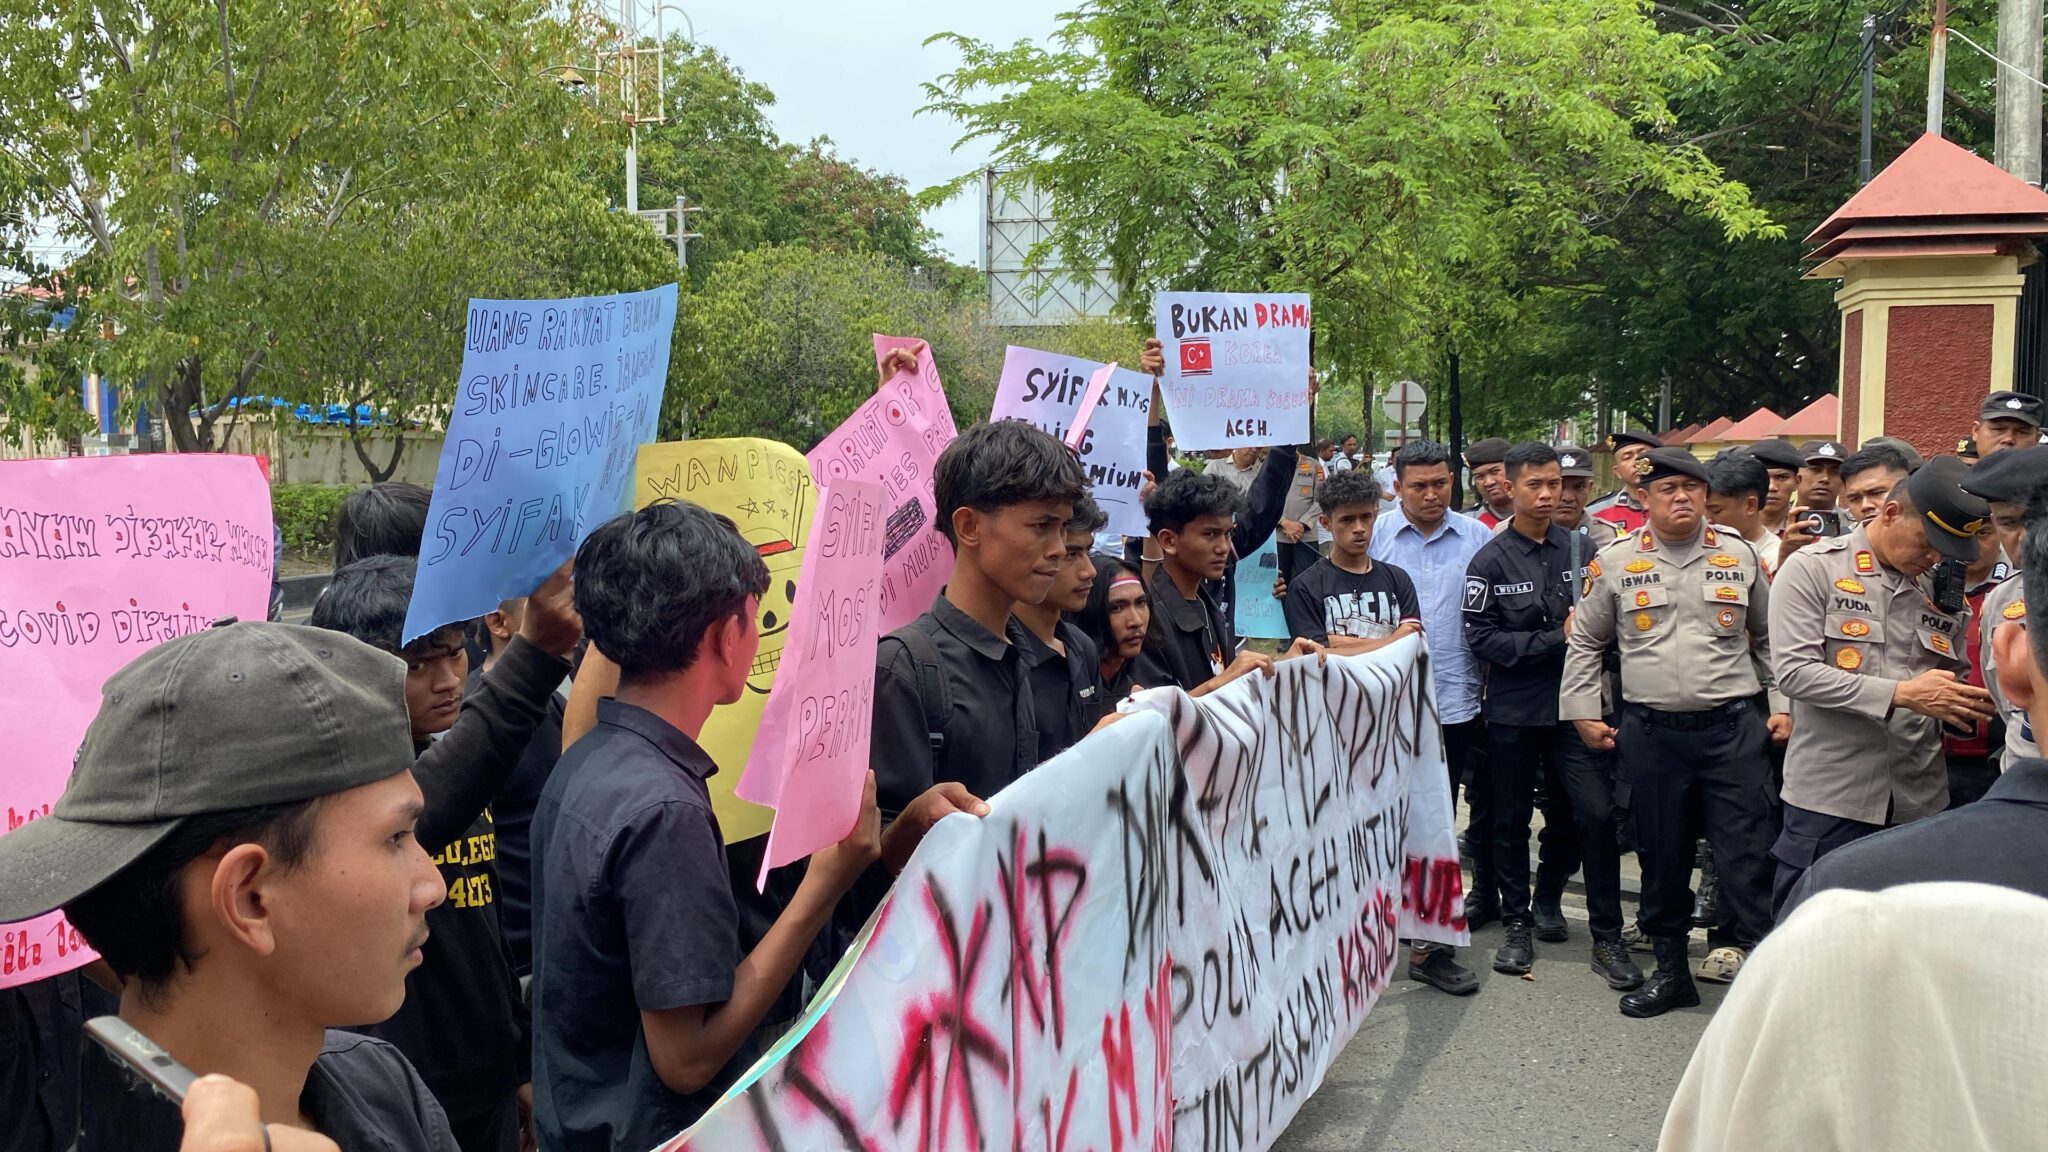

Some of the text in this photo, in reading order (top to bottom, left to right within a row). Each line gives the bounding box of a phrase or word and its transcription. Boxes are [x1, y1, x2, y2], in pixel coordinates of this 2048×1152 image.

[469, 308, 532, 353] UANG
[539, 302, 616, 350] RAKYAT
[1171, 303, 1310, 338] BUKAN DRAMA
[1224, 341, 1283, 366] KOREA
[1204, 387, 1260, 410] DRAMA
[1499, 584, 1528, 594] WOYLA
[1621, 571, 1745, 588] ISWAR POLRI
[1835, 597, 1953, 633] YUDA POLRI
[1269, 837, 1340, 961] ACEH
[1337, 887, 1397, 1021] KASUS
